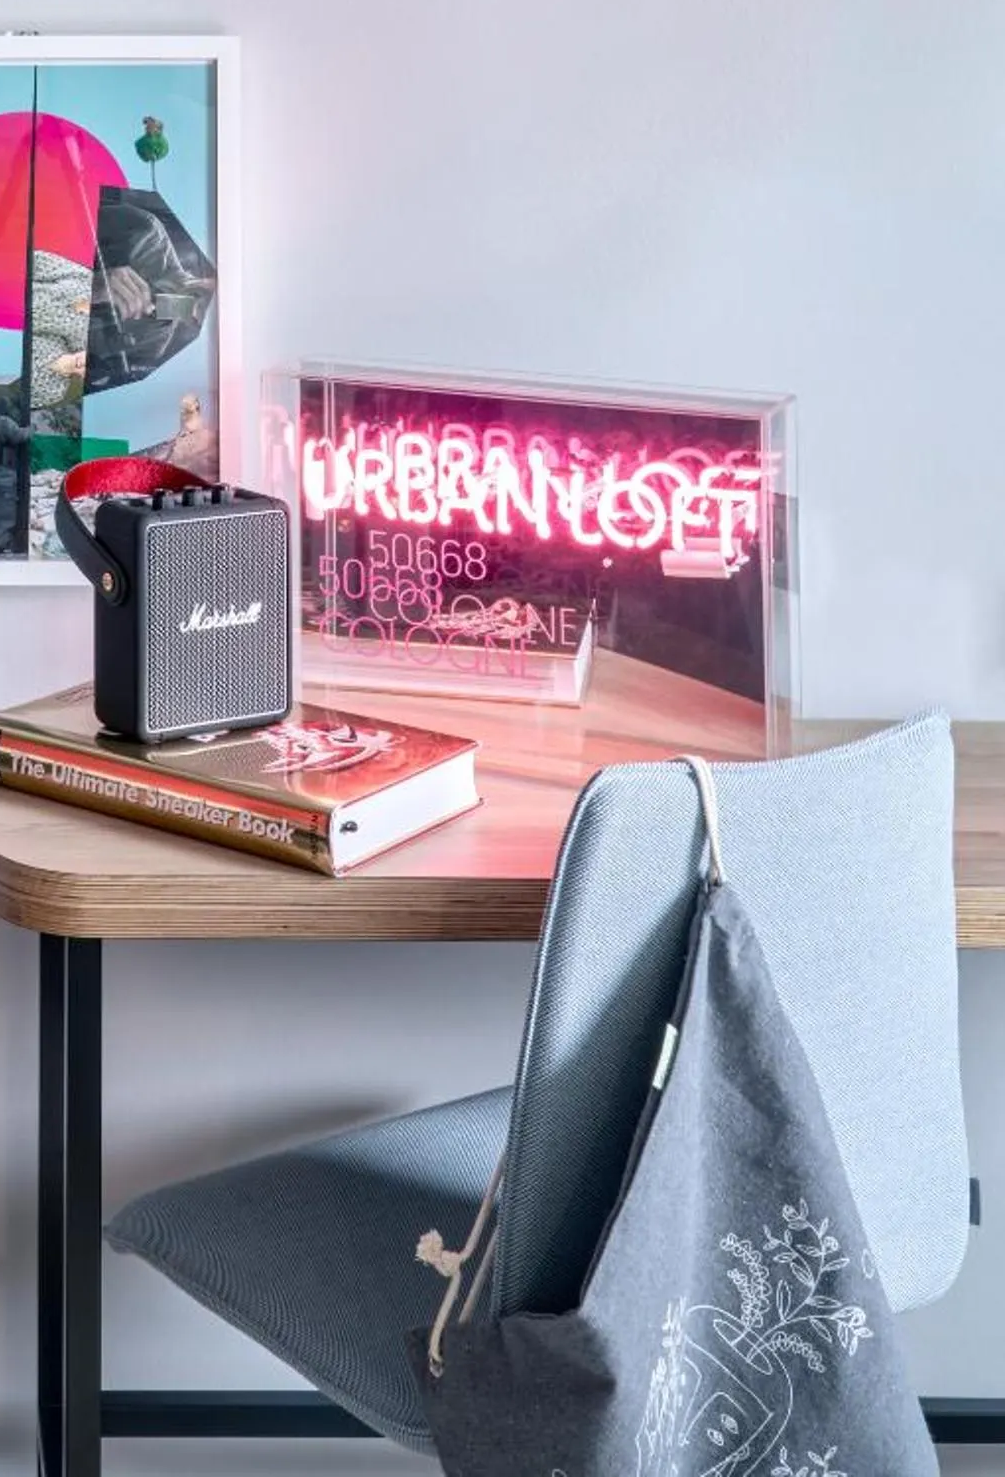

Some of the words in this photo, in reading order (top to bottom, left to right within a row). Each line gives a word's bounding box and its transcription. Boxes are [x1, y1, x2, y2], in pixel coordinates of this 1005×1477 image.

[303, 436, 552, 540] URBAN
[568, 469, 758, 562] LOFT
[369, 529, 487, 580] 50668
[180, 602, 262, 634] Marshall
[10, 752, 45, 779] The
[50, 761, 138, 803] Ultimate
[145, 784, 233, 828] Sneaker
[238, 808, 295, 844] Book
